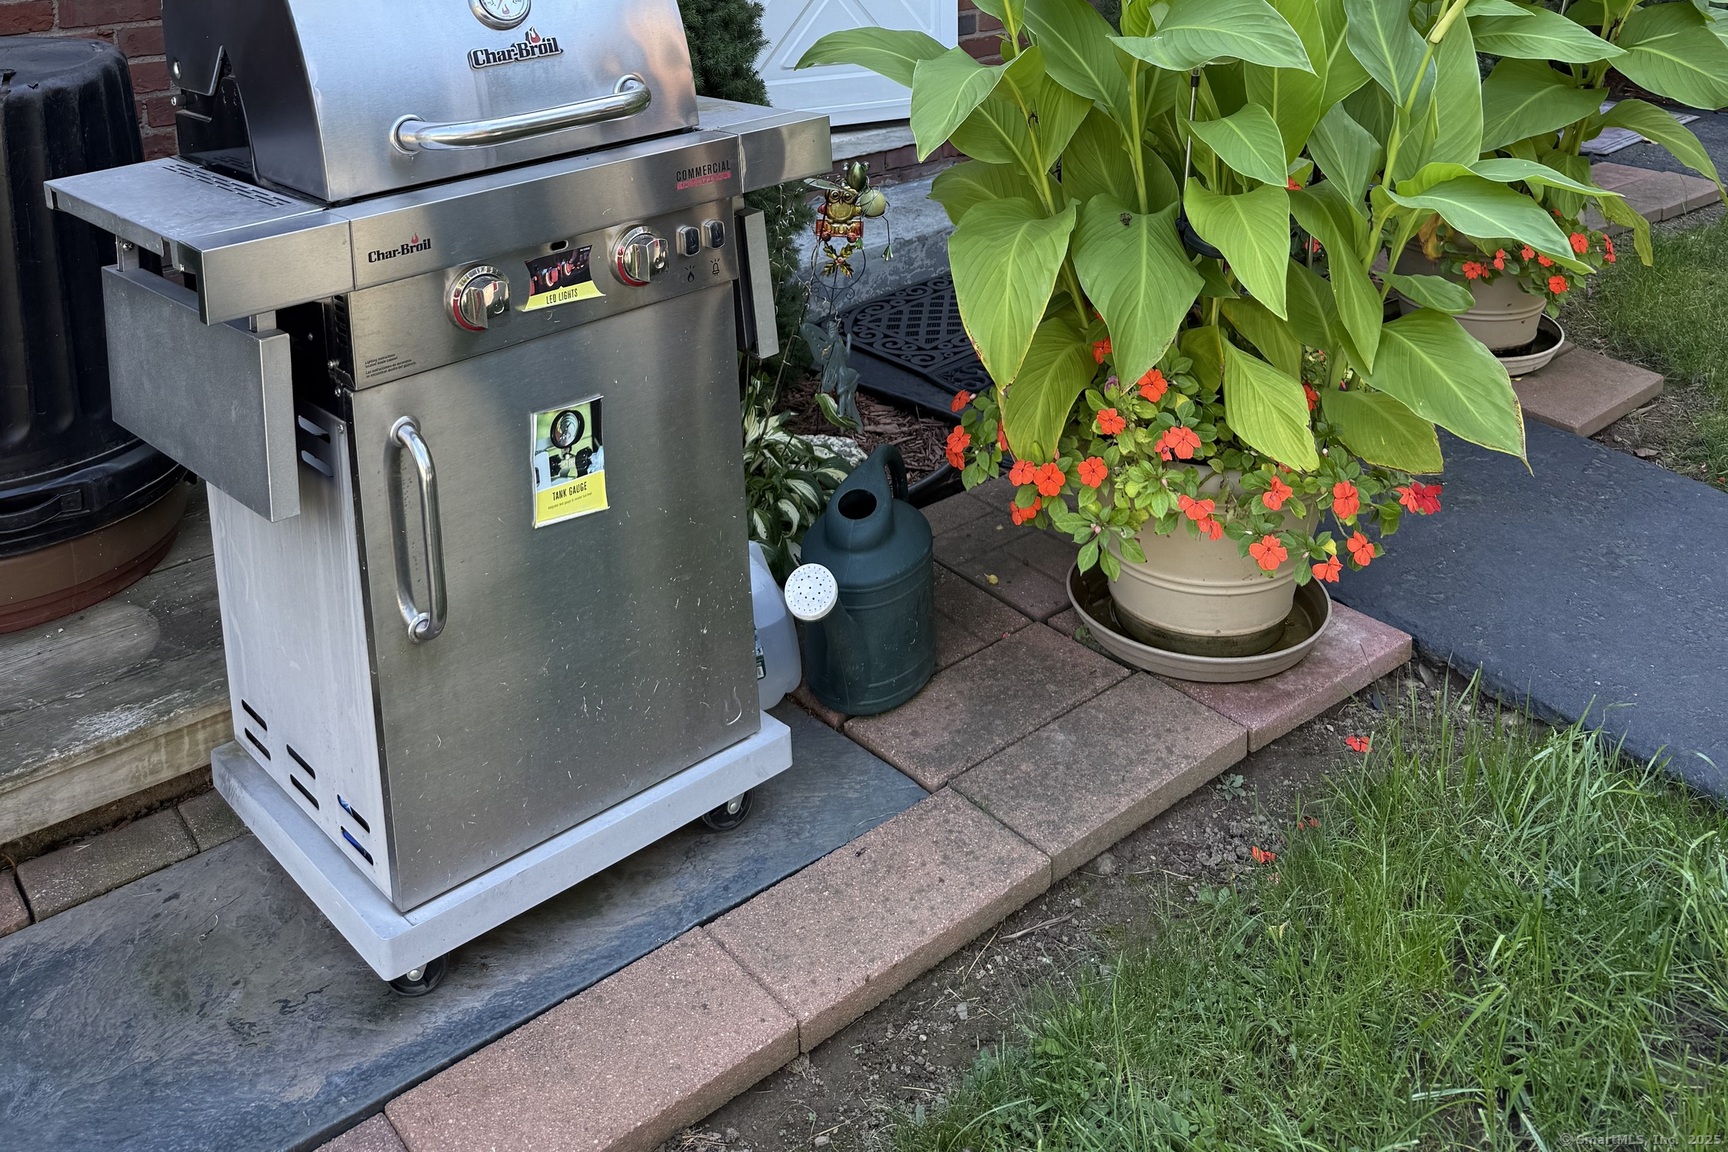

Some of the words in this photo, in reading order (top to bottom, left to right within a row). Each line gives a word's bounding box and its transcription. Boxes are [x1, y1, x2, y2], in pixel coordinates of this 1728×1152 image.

[473, 37, 561, 67] Char-Broil
[675, 160, 731, 182] COMMERCIAL
[367, 238, 432, 263] Char-Broil
[545, 293, 557, 305] LED
[558, 288, 578, 302] LIGHTS
[552, 488, 567, 501] TANK
[568, 481, 587, 496] GAUGE
